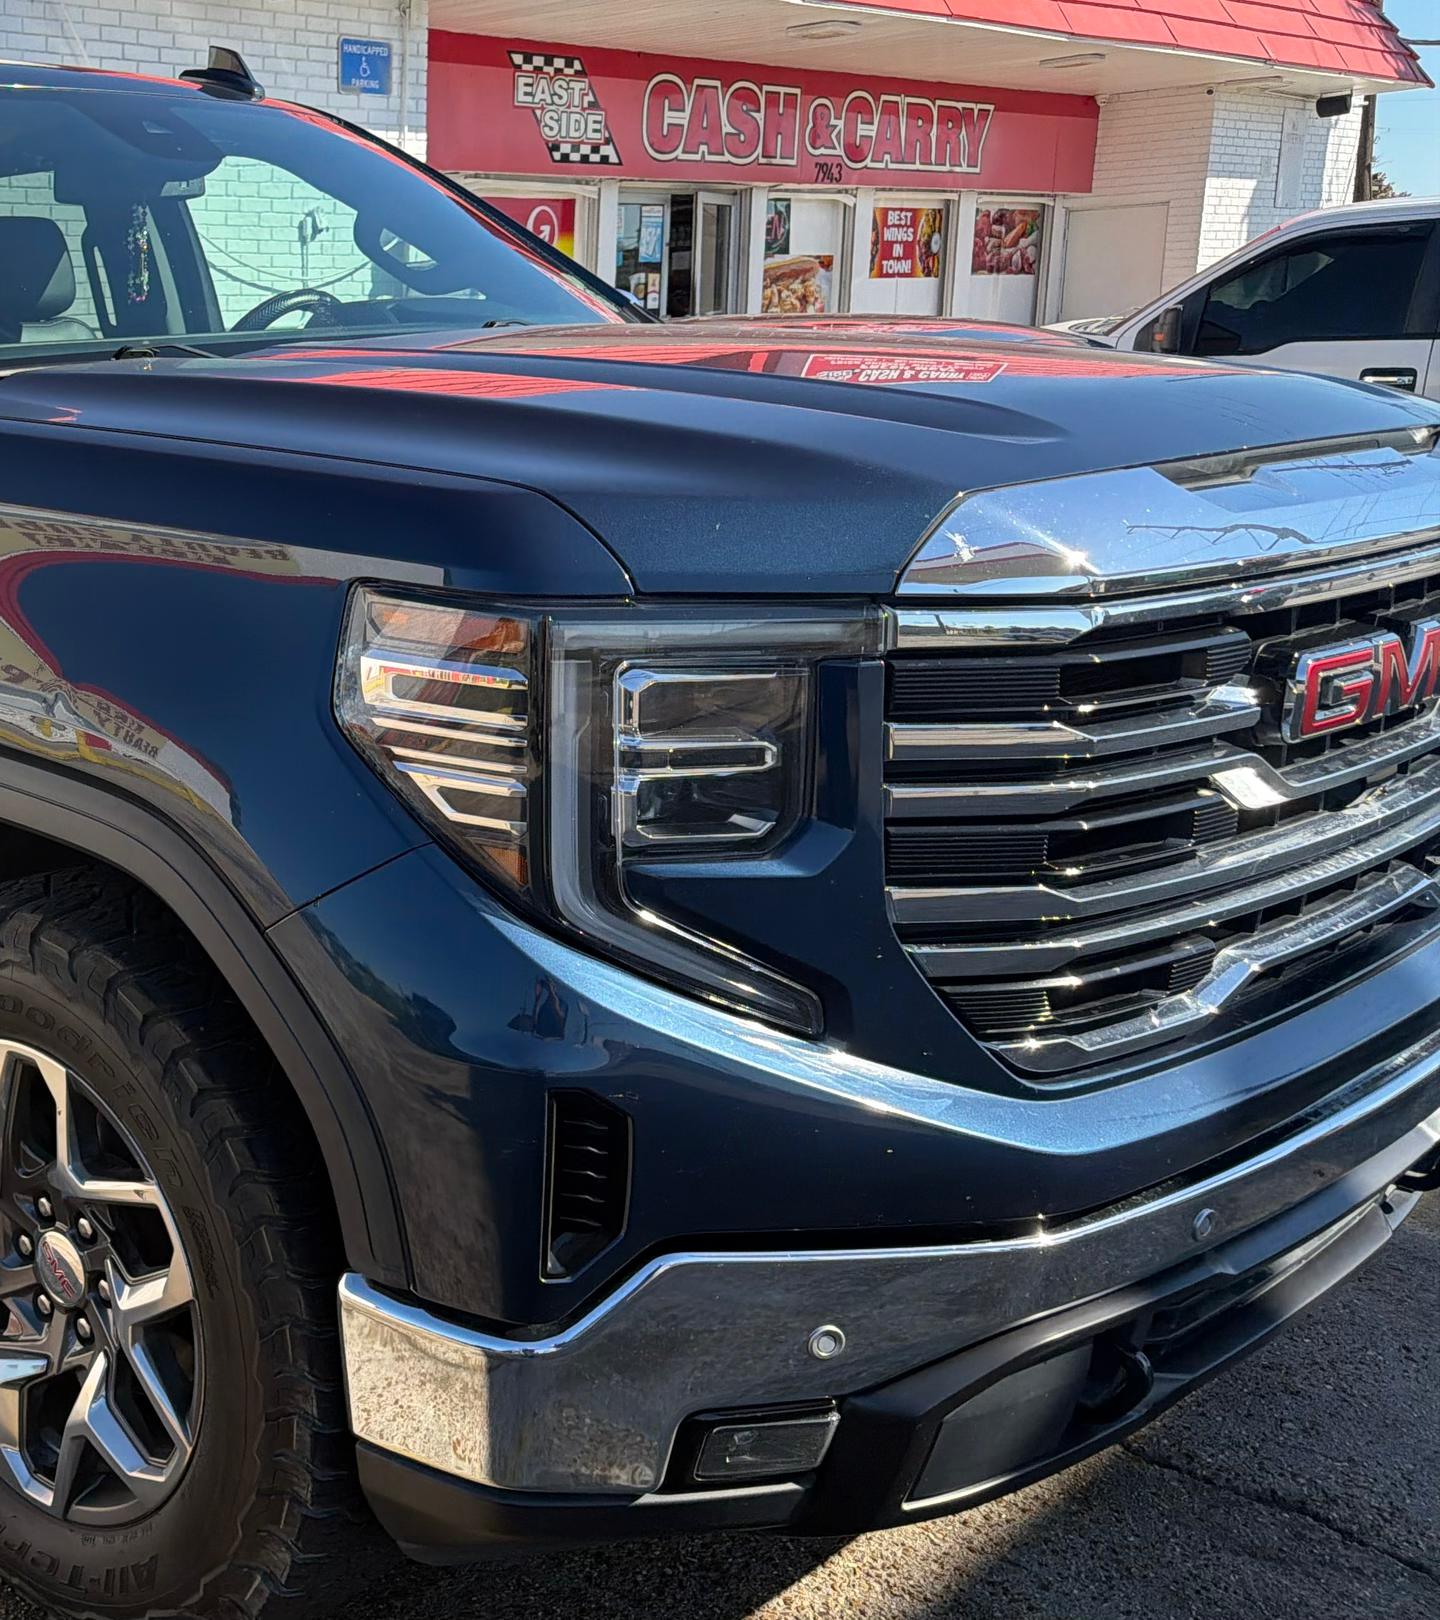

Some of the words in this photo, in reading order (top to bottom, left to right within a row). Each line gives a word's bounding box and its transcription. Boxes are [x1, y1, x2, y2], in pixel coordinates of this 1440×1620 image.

[343, 44, 388, 56] HANDICAPPED
[351, 78, 380, 89] PARKING
[514, 72, 588, 108] EAST
[540, 108, 605, 142] SIDE
[642, 73, 802, 165] CASH
[805, 97, 843, 155] &
[841, 90, 995, 174] CARRY
[814, 162, 843, 183] 7943
[887, 210, 913, 226] BEST
[883, 227, 914, 242] WINGS
[892, 243, 904, 258] IN
[882, 260, 912, 274] TOWN!
[42, 1240, 77, 1300] GMC
